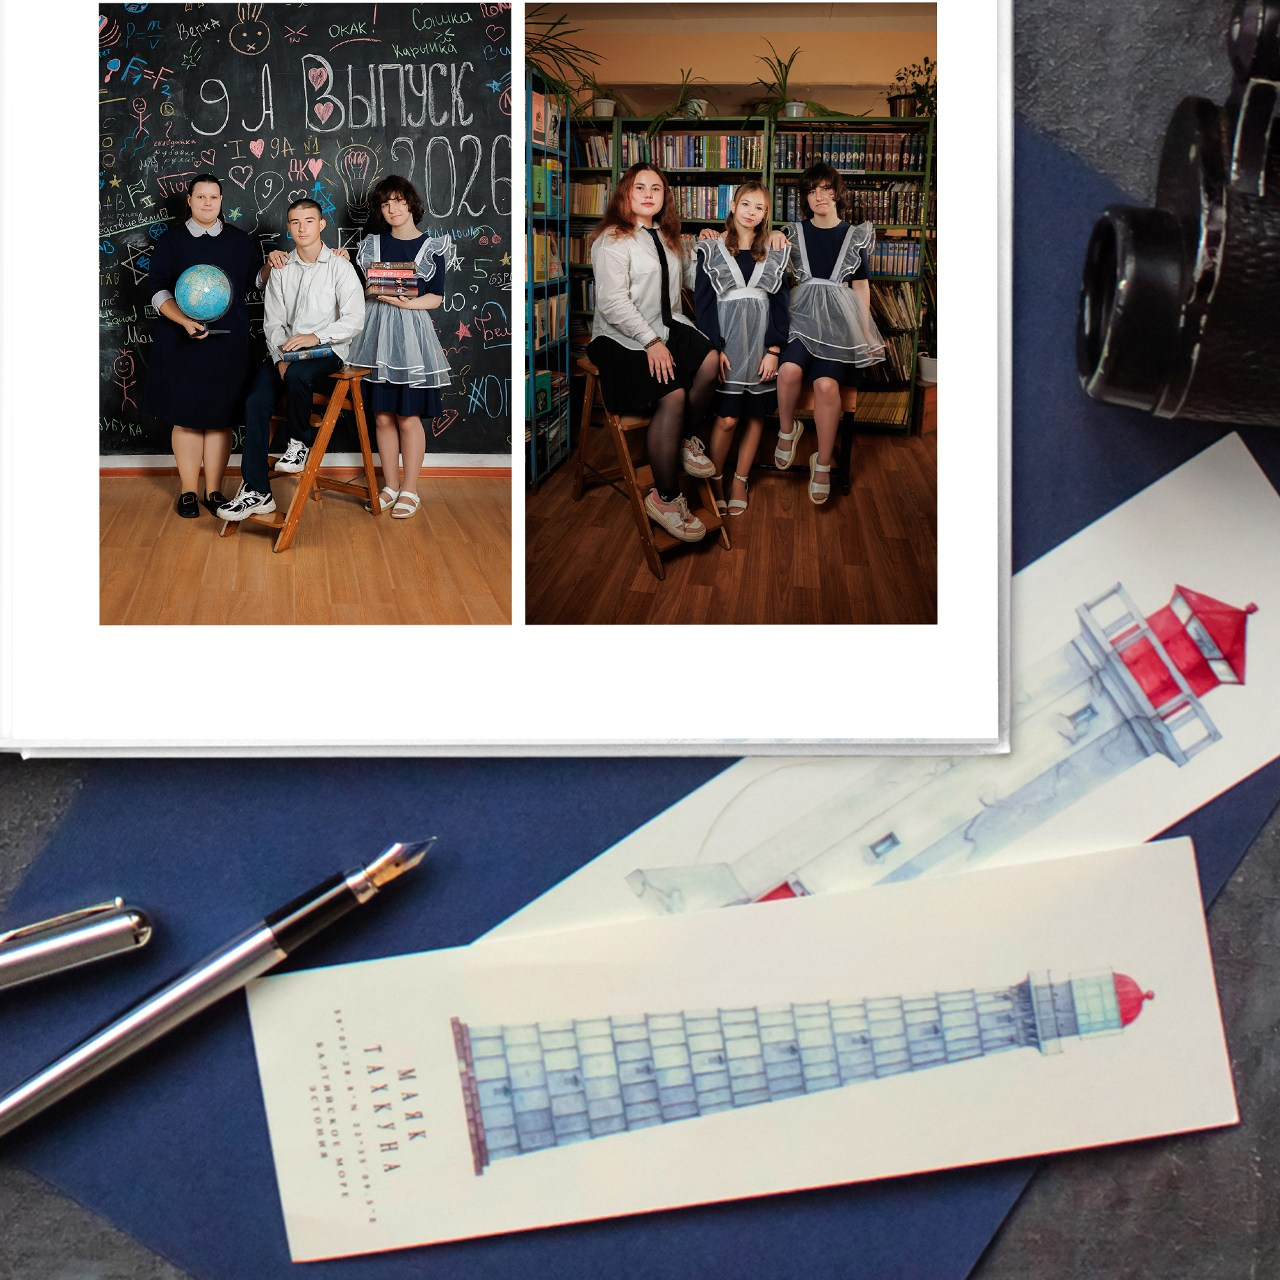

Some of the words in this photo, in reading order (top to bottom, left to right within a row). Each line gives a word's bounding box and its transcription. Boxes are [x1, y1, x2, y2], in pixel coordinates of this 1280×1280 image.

[190, 78, 230, 136] 9
[309, 1084, 328, 1159] ЭСТОНИЯ
[363, 1044, 401, 1173] ТАХКУНА
[398, 1067, 426, 1141] МАЯК
[336, 1156, 350, 1198] МОРЕ
